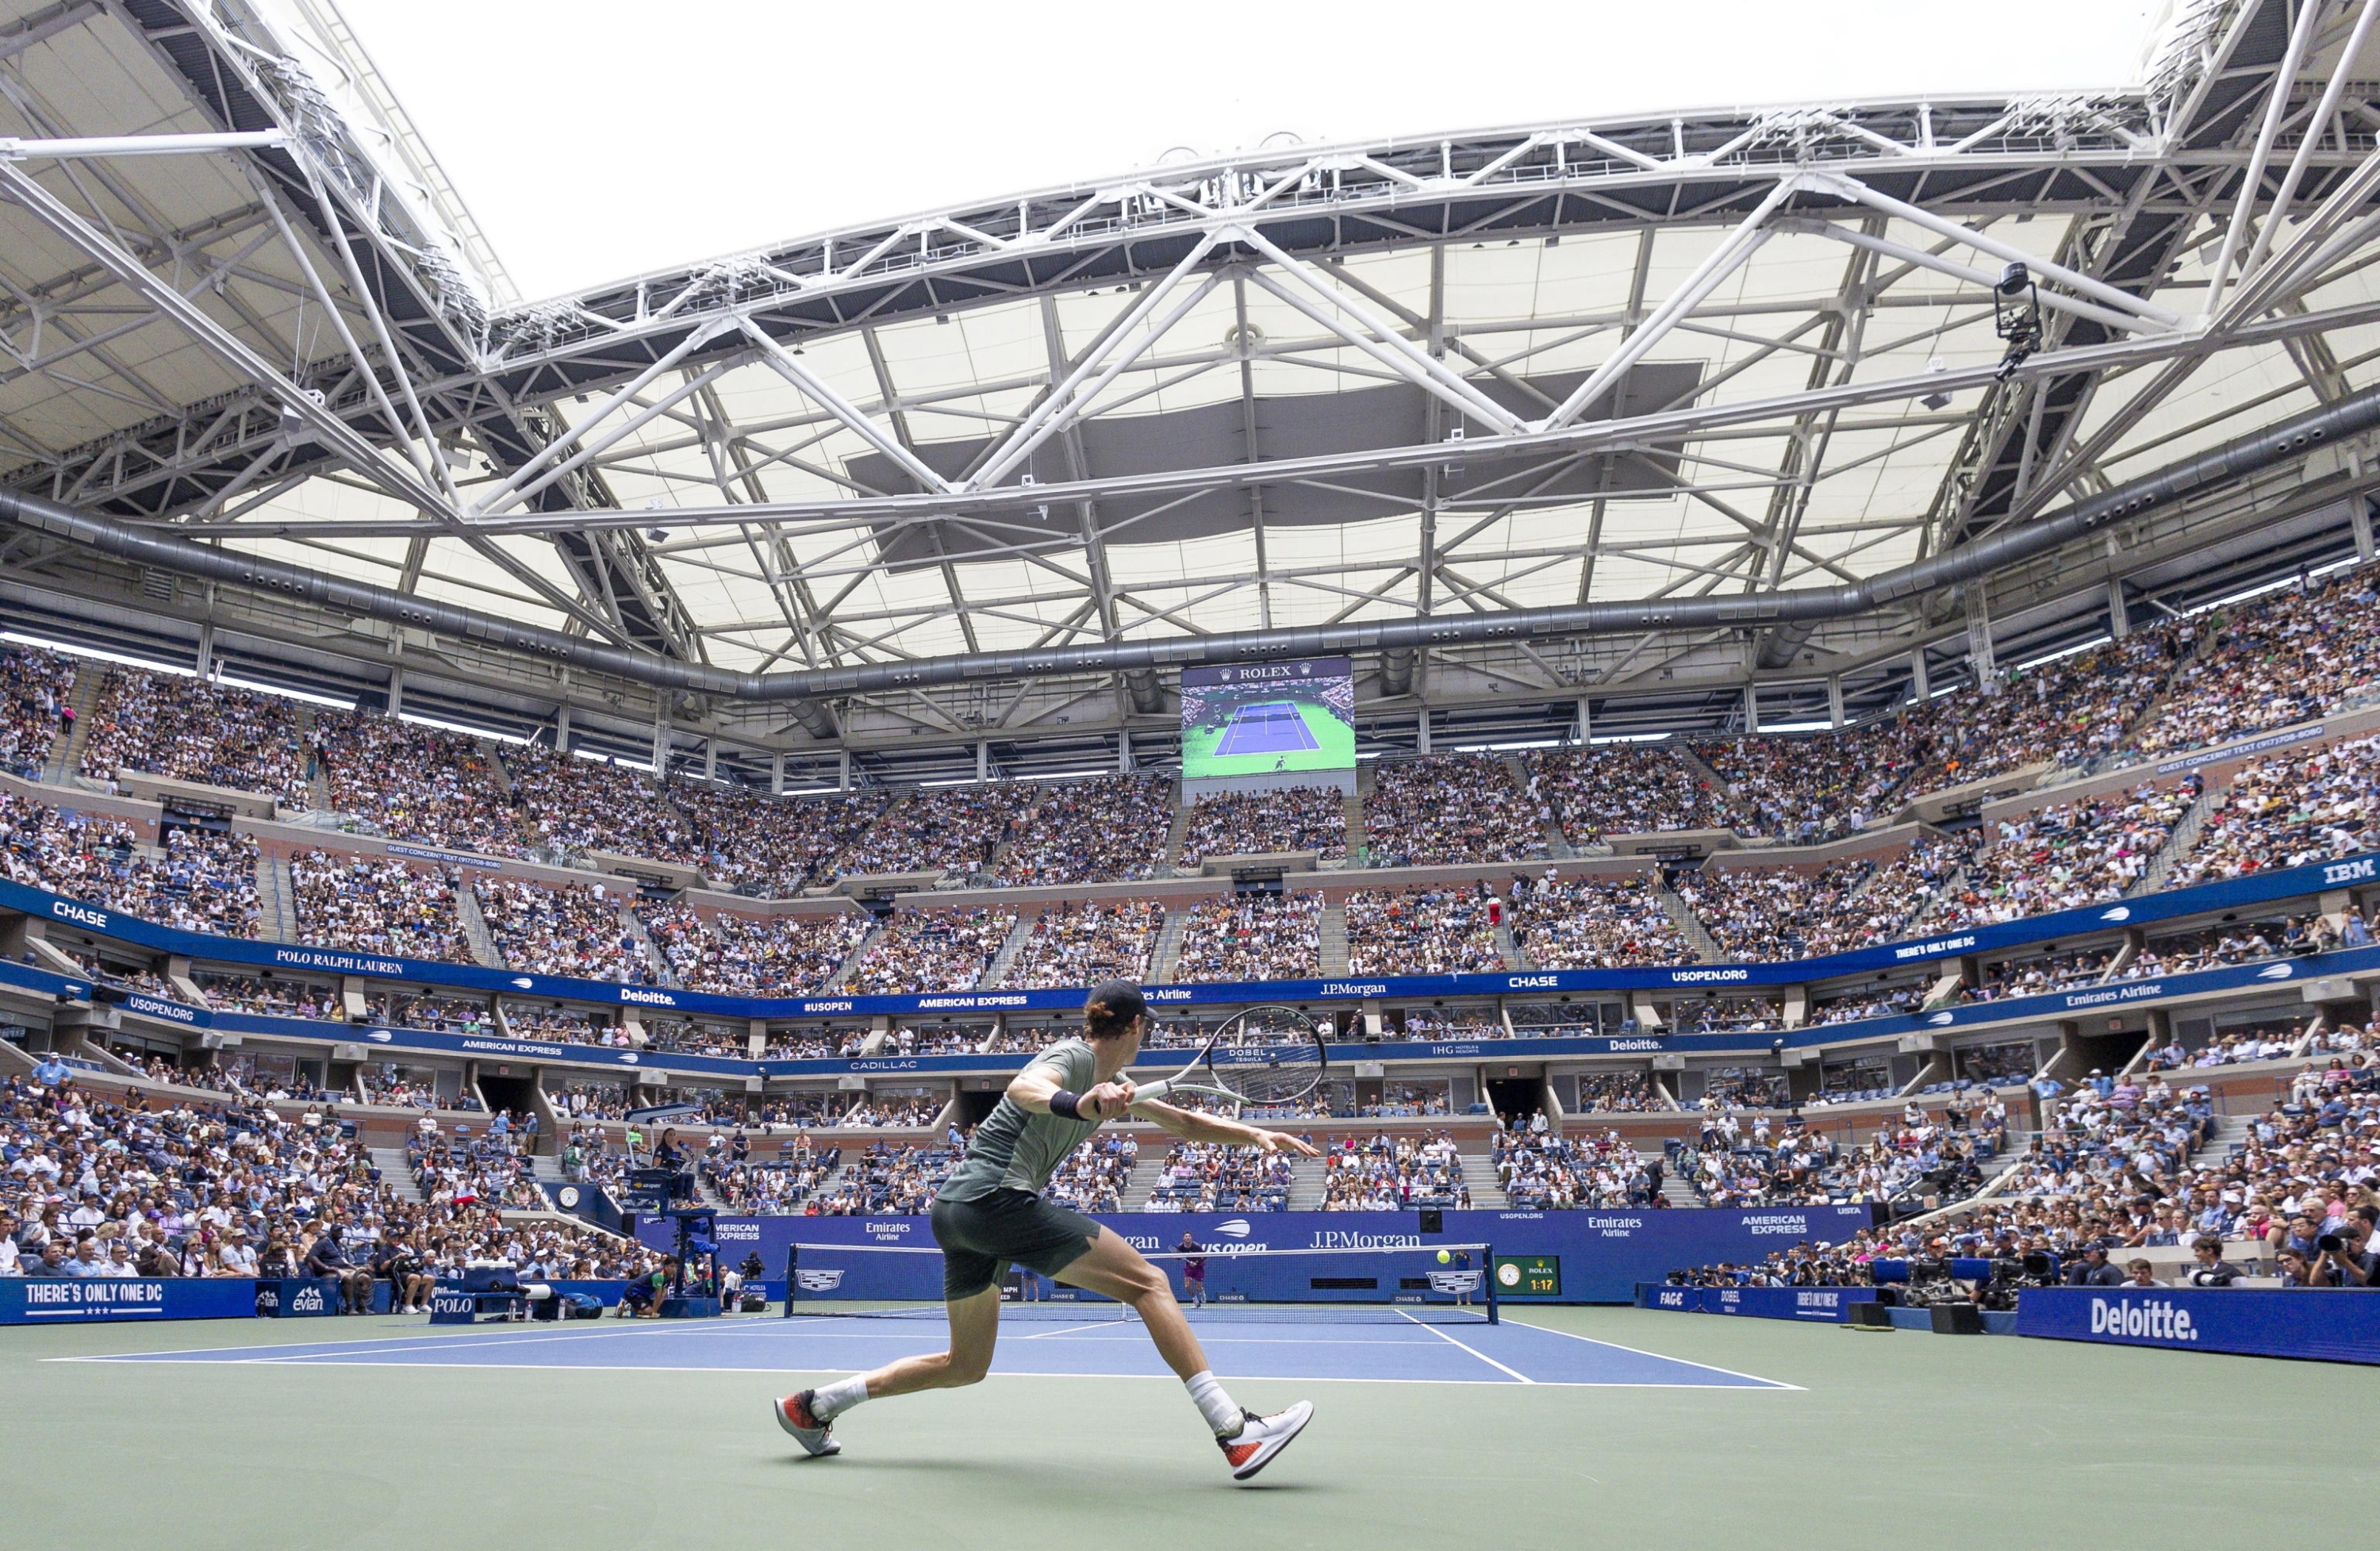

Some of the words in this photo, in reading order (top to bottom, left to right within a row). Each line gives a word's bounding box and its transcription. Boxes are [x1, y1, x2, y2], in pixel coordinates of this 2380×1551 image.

[1239, 666, 1292, 679] ROLEX
[2234, 743, 2255, 754] TEXT
[388, 845, 408, 854] GUEST
[409, 847, 442, 859] CONCERN?
[443, 853, 457, 862] TEXT
[2324, 859, 2375, 883] IBM
[52, 900, 107, 928] CHASE
[1895, 945, 1925, 958] THERE'S
[1927, 942, 1946, 954] ONLY
[1947, 939, 1963, 950] ONE
[1964, 936, 1975, 946] DC
[276, 950, 311, 967] POLO
[314, 953, 354, 970] RALPH
[356, 956, 403, 974] LAUREN
[1509, 976, 1557, 988] CHASE
[1672, 969, 1747, 982] USOPEN.ORG
[1157, 989, 1192, 1000] Airline
[1320, 983, 1386, 996] J.P.Morgan
[2067, 989, 2117, 1008] Emirates
[2121, 983, 2161, 1001] Airline
[620, 988, 676, 1006] Deloitte.
[918, 997, 975, 1008] AMERICAN
[977, 996, 1027, 1006] EXPRESS
[130, 996, 194, 1022] USOPEN.ORG
[804, 1000, 852, 1012] #USOPEN
[463, 1040, 516, 1051] AMERICAN
[517, 1045, 562, 1055] EXPRESS
[1433, 1046, 1453, 1054] IHG
[1610, 1039, 1662, 1051] Deloitte.
[850, 1060, 917, 1070] CADILLAC
[1588, 1216, 1642, 1228] Emirates
[1741, 1215, 1805, 1226] AMERICAN
[866, 1222, 910, 1233] Emirates
[1601, 1228, 1630, 1238] Airline
[1752, 1225, 1807, 1234] EXPRESS
[1310, 1231, 1420, 1253] J.P.Morgan
[1530, 1279, 1553, 1290] 1:17
[26, 1282, 81, 1303] THERE'S
[86, 1284, 117, 1303] ONLY
[120, 1283, 144, 1302] ONE
[147, 1283, 163, 1301] DC
[1660, 1292, 1683, 1306] FAGE
[1722, 1290, 1741, 1302] DOBEL
[255, 1297, 278, 1307] eian
[293, 1296, 323, 1311] evian
[434, 1298, 472, 1314] POLO
[2090, 1298, 2198, 1342] Deloitte.
